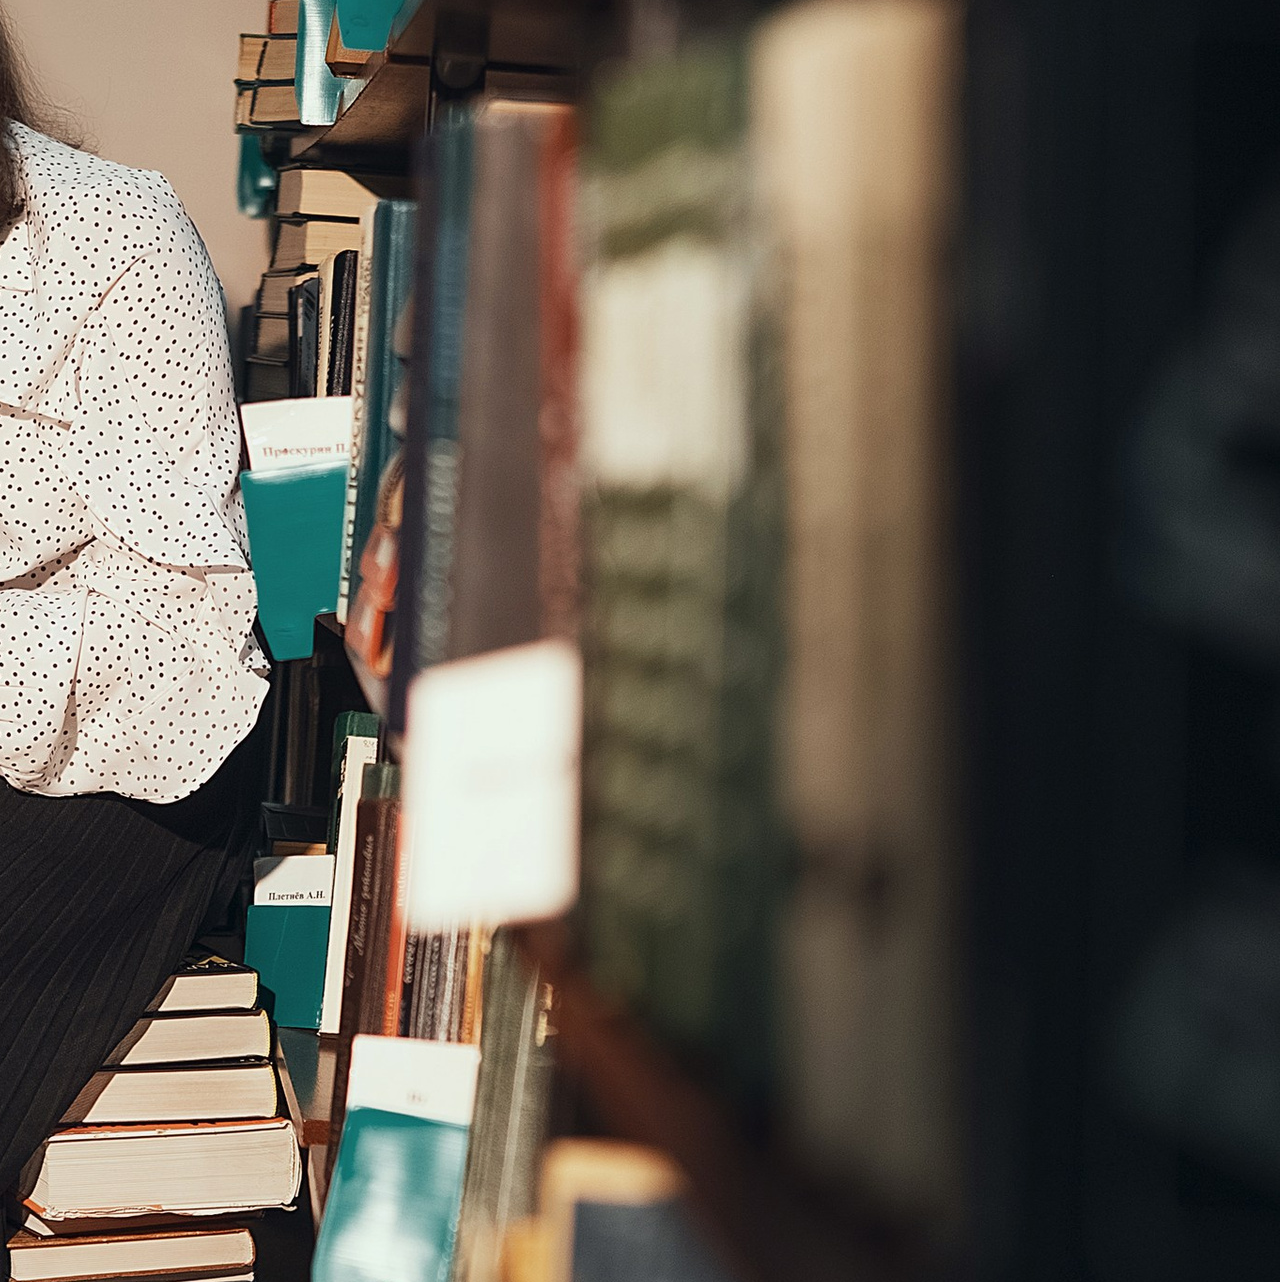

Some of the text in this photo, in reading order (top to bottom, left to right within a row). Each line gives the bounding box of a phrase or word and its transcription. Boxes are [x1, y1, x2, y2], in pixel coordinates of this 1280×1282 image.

[262, 446, 332, 459] Проскурин
[268, 890, 326, 902] Плетнёв А.Н.
